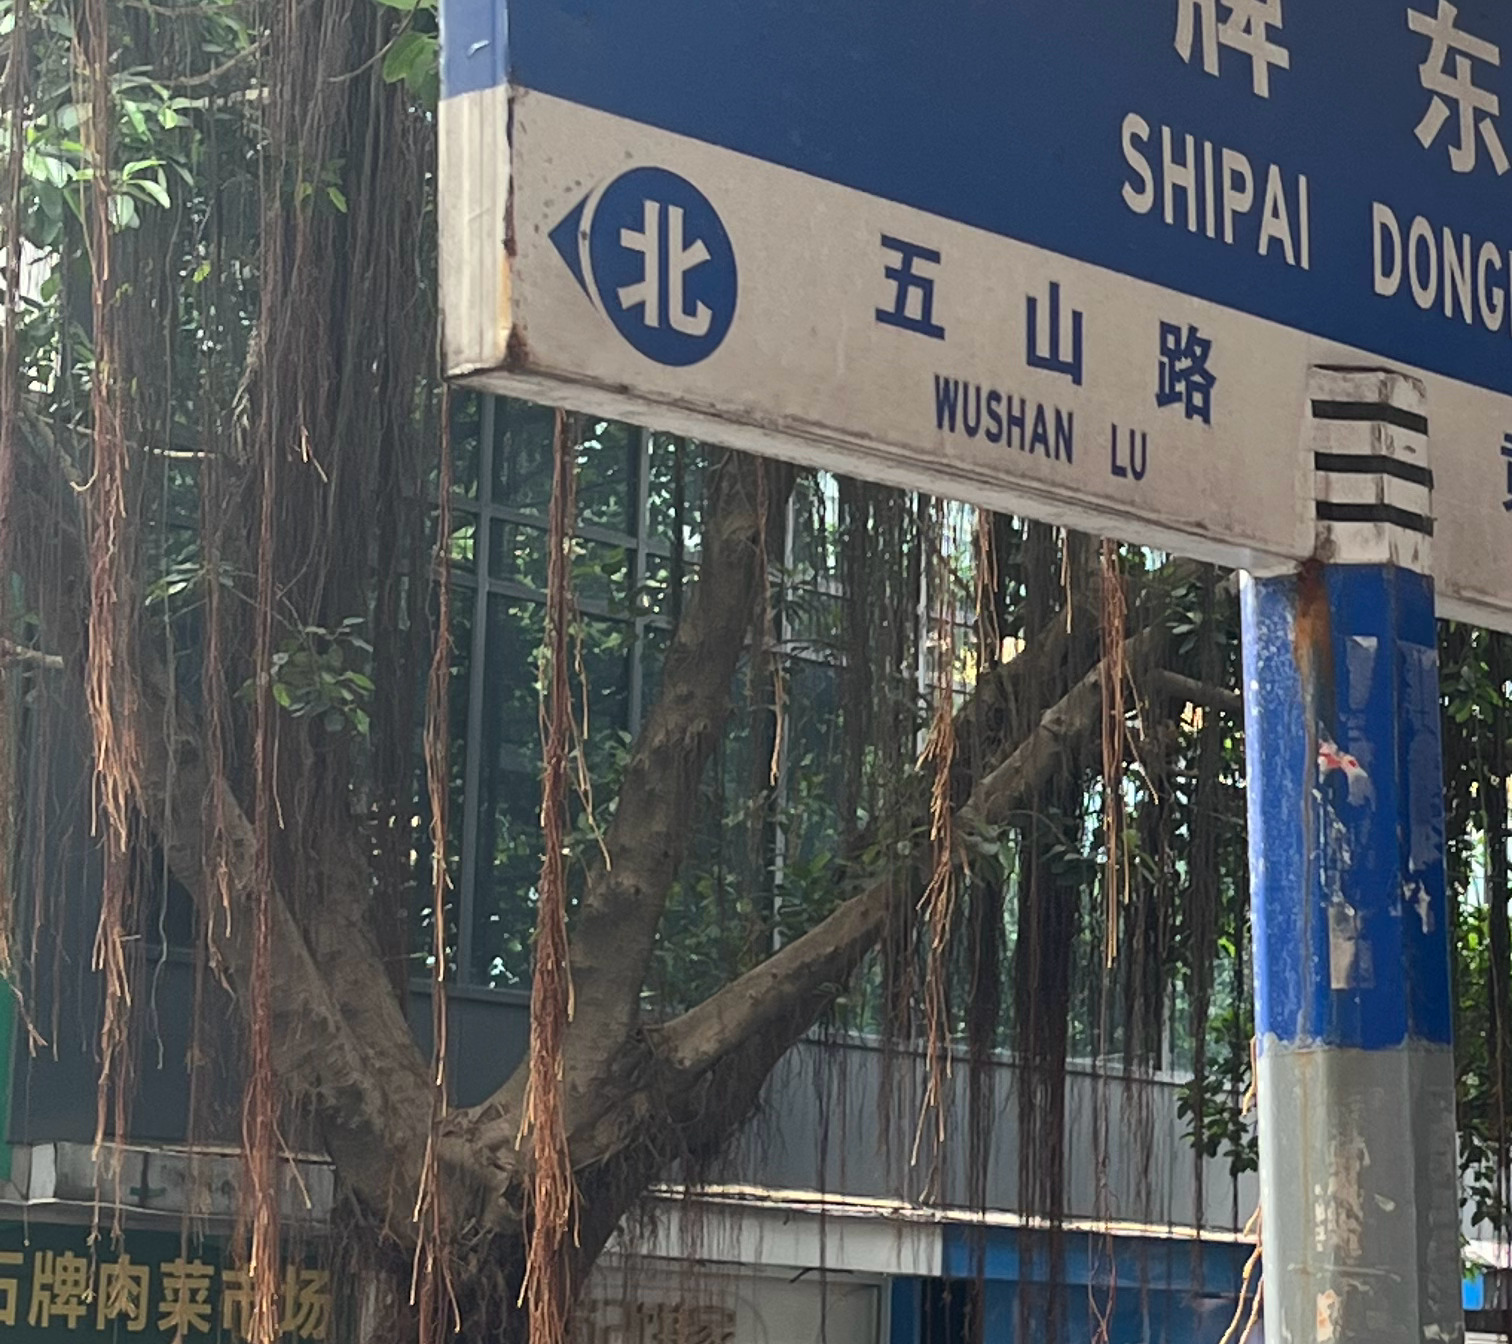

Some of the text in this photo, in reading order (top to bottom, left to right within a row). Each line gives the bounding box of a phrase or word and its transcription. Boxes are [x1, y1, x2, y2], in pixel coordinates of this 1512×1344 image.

[1122, 113, 1310, 270] SHIPAI
[617, 204, 713, 338] 北
[875, 236, 1217, 427] 五山路
[934, 374, 1147, 482] WUSHAN LU
